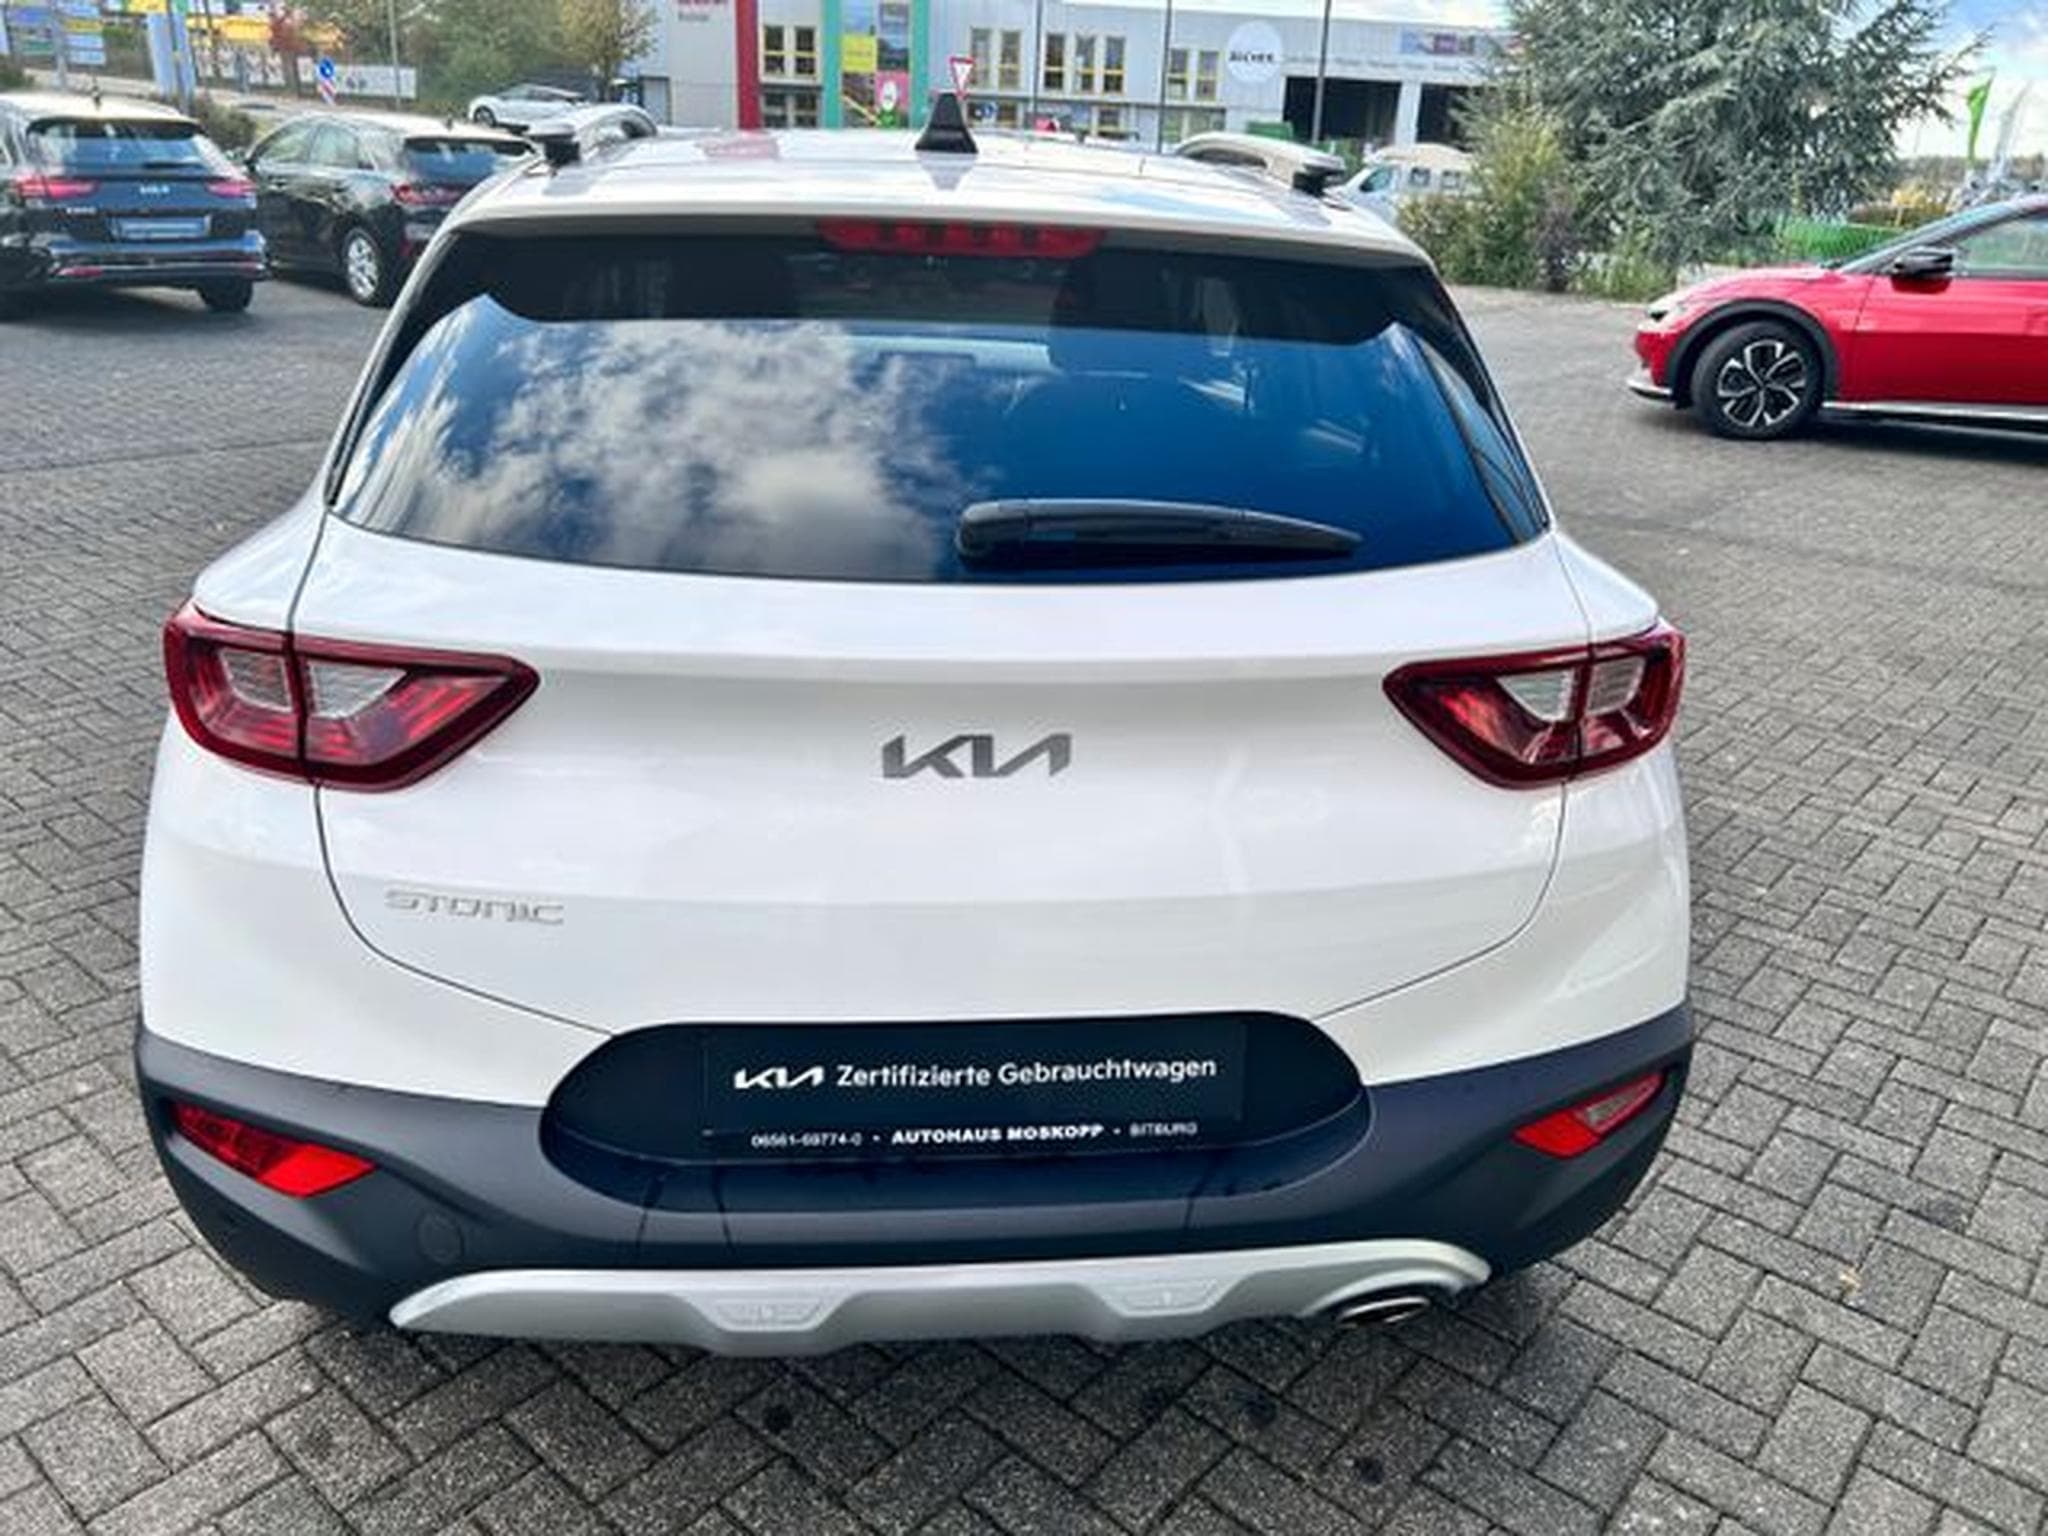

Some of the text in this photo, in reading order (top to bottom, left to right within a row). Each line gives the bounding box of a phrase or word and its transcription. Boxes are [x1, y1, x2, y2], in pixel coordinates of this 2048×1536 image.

[882, 733, 1071, 779] KIA
[385, 888, 565, 926] STONIC
[733, 1058, 1218, 1090] KIA Zertifizierte Gebrauchtwagen
[891, 1127, 1003, 1145] AUTOHAUS
[1006, 1123, 1105, 1142] MOSKOPP
